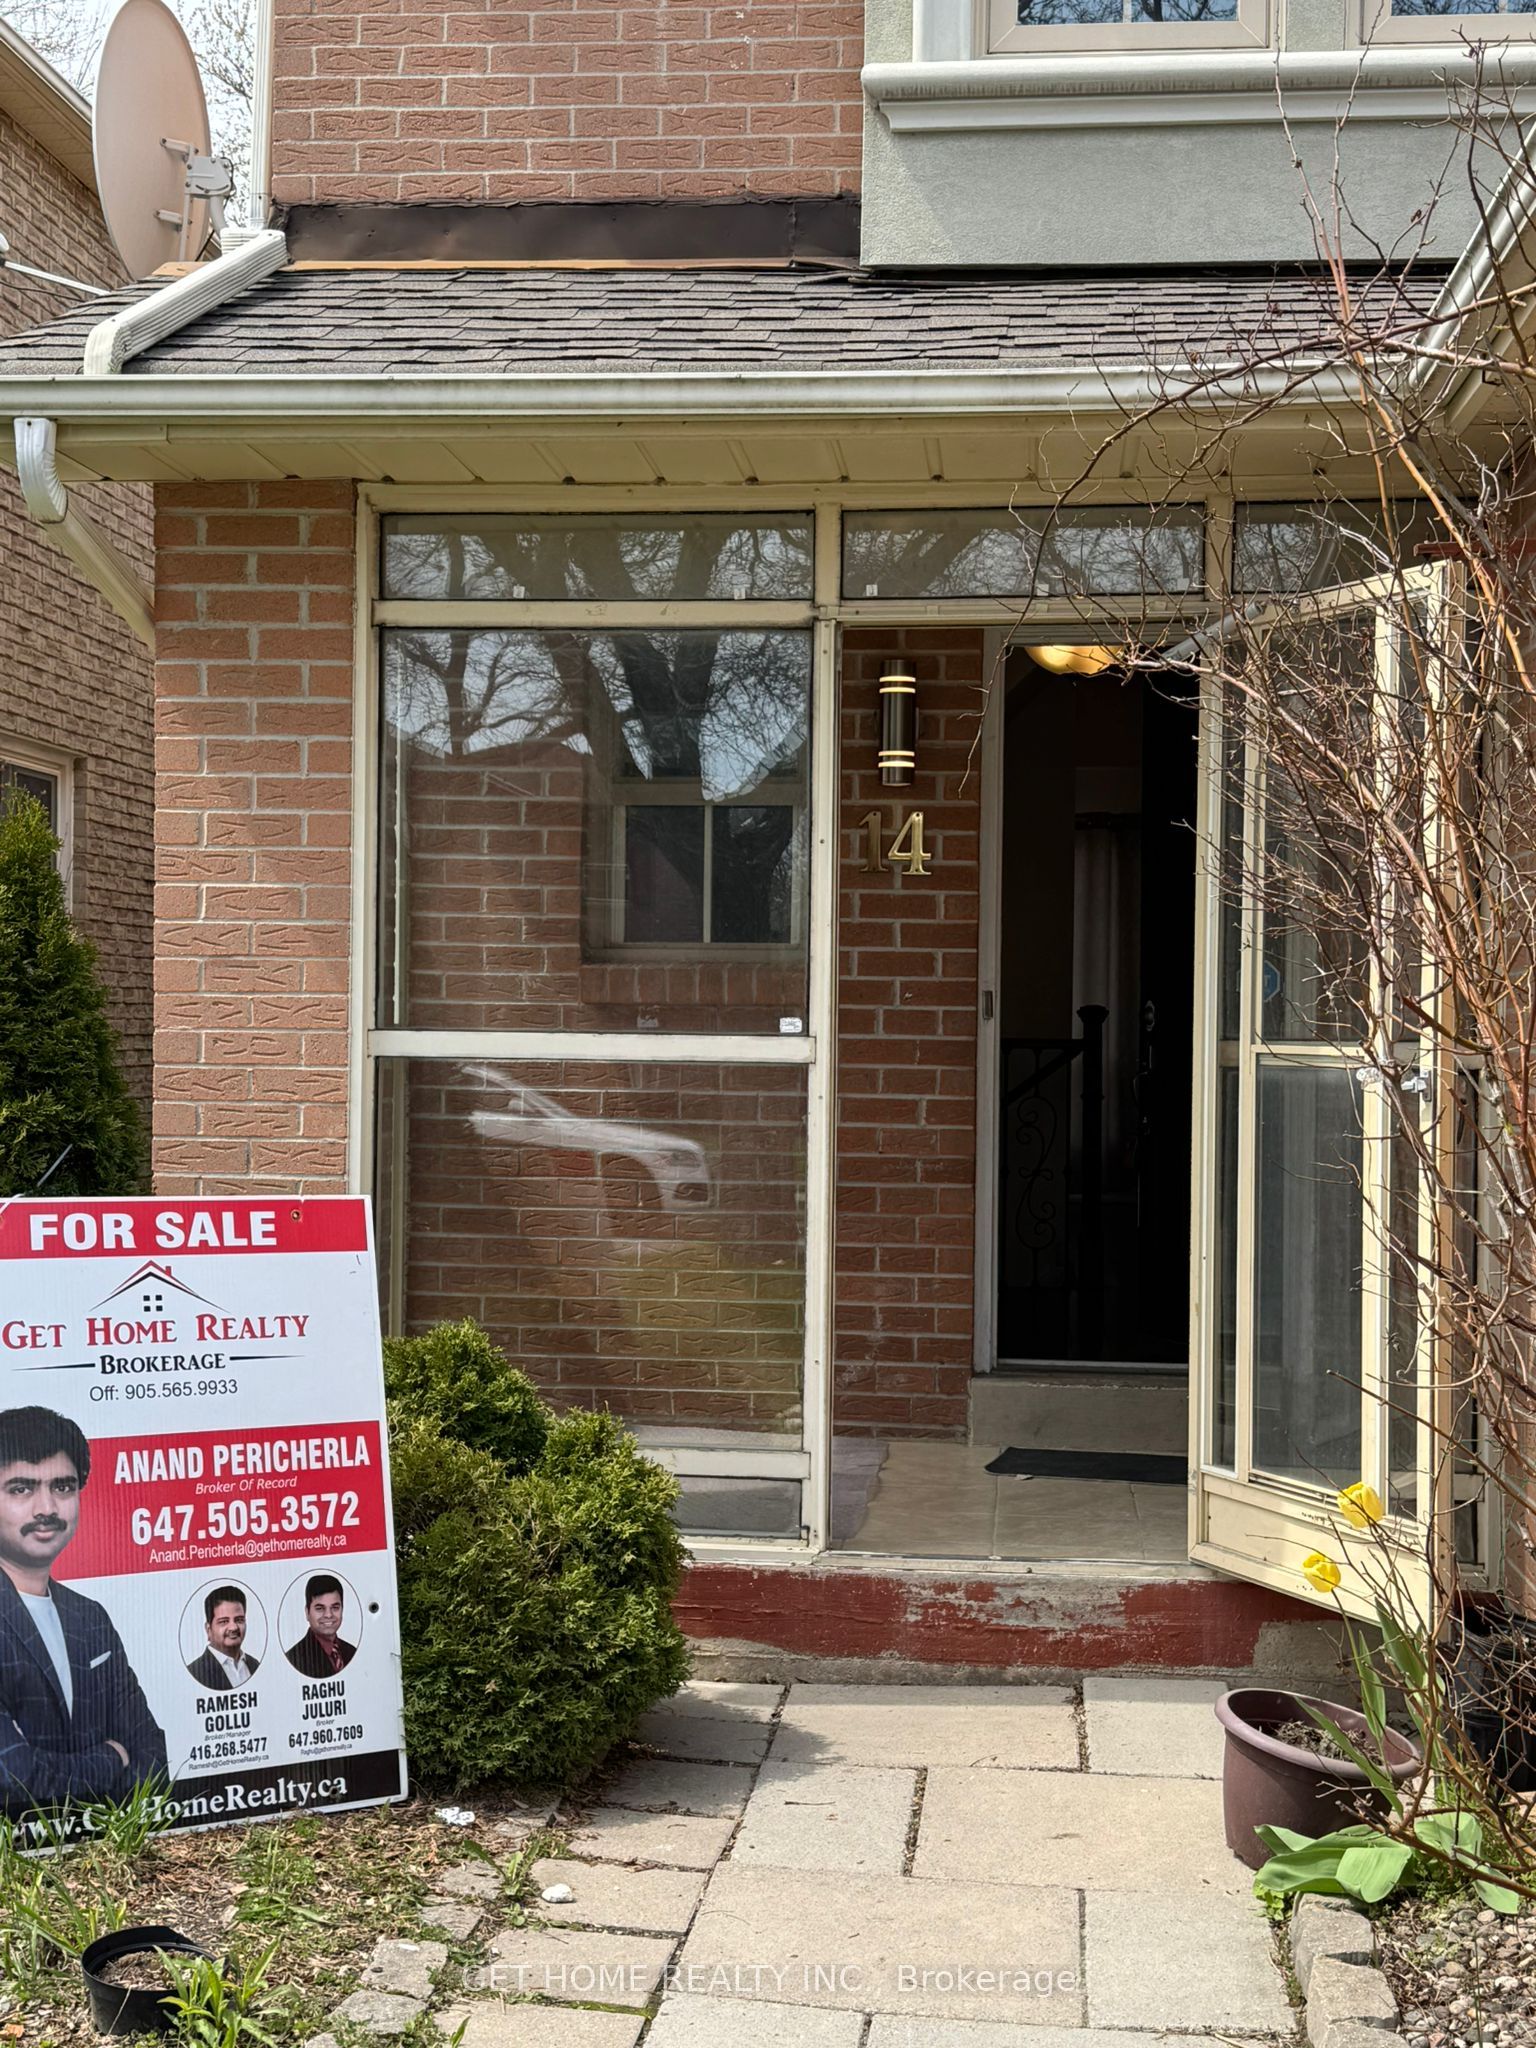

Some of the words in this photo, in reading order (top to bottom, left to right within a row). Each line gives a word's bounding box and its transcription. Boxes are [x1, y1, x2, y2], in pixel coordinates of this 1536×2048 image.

[858, 810, 932, 876] 14
[29, 1212, 137, 1251] FOR
[155, 1210, 278, 1249] SALE
[1, 1320, 67, 1349] GET
[86, 1317, 177, 1346] HOME
[195, 1314, 311, 1341] REALTY
[99, 1353, 226, 1375] BROKERAGE
[89, 1385, 119, 1401] Off:
[125, 1379, 238, 1400] 905.565.9933
[114, 1446, 204, 1485] ANAND
[213, 1435, 371, 1477] PERICHERLA
[195, 1482, 236, 1495] Broker
[239, 1479, 255, 1491] Of
[257, 1476, 297, 1490] Record
[131, 1491, 360, 1546] 647.505.3572
[149, 1533, 347, 1564] Anand.Pericherla@gethomerealty.ca
[302, 1680, 345, 1701] RAGHU
[196, 1691, 258, 1715] RAMESH
[302, 1699, 347, 1720] JULURI
[205, 1711, 250, 1733] GOLLU
[288, 1724, 363, 1748] 647.960.7609
[190, 1737, 267, 1761] 416.268.5477
